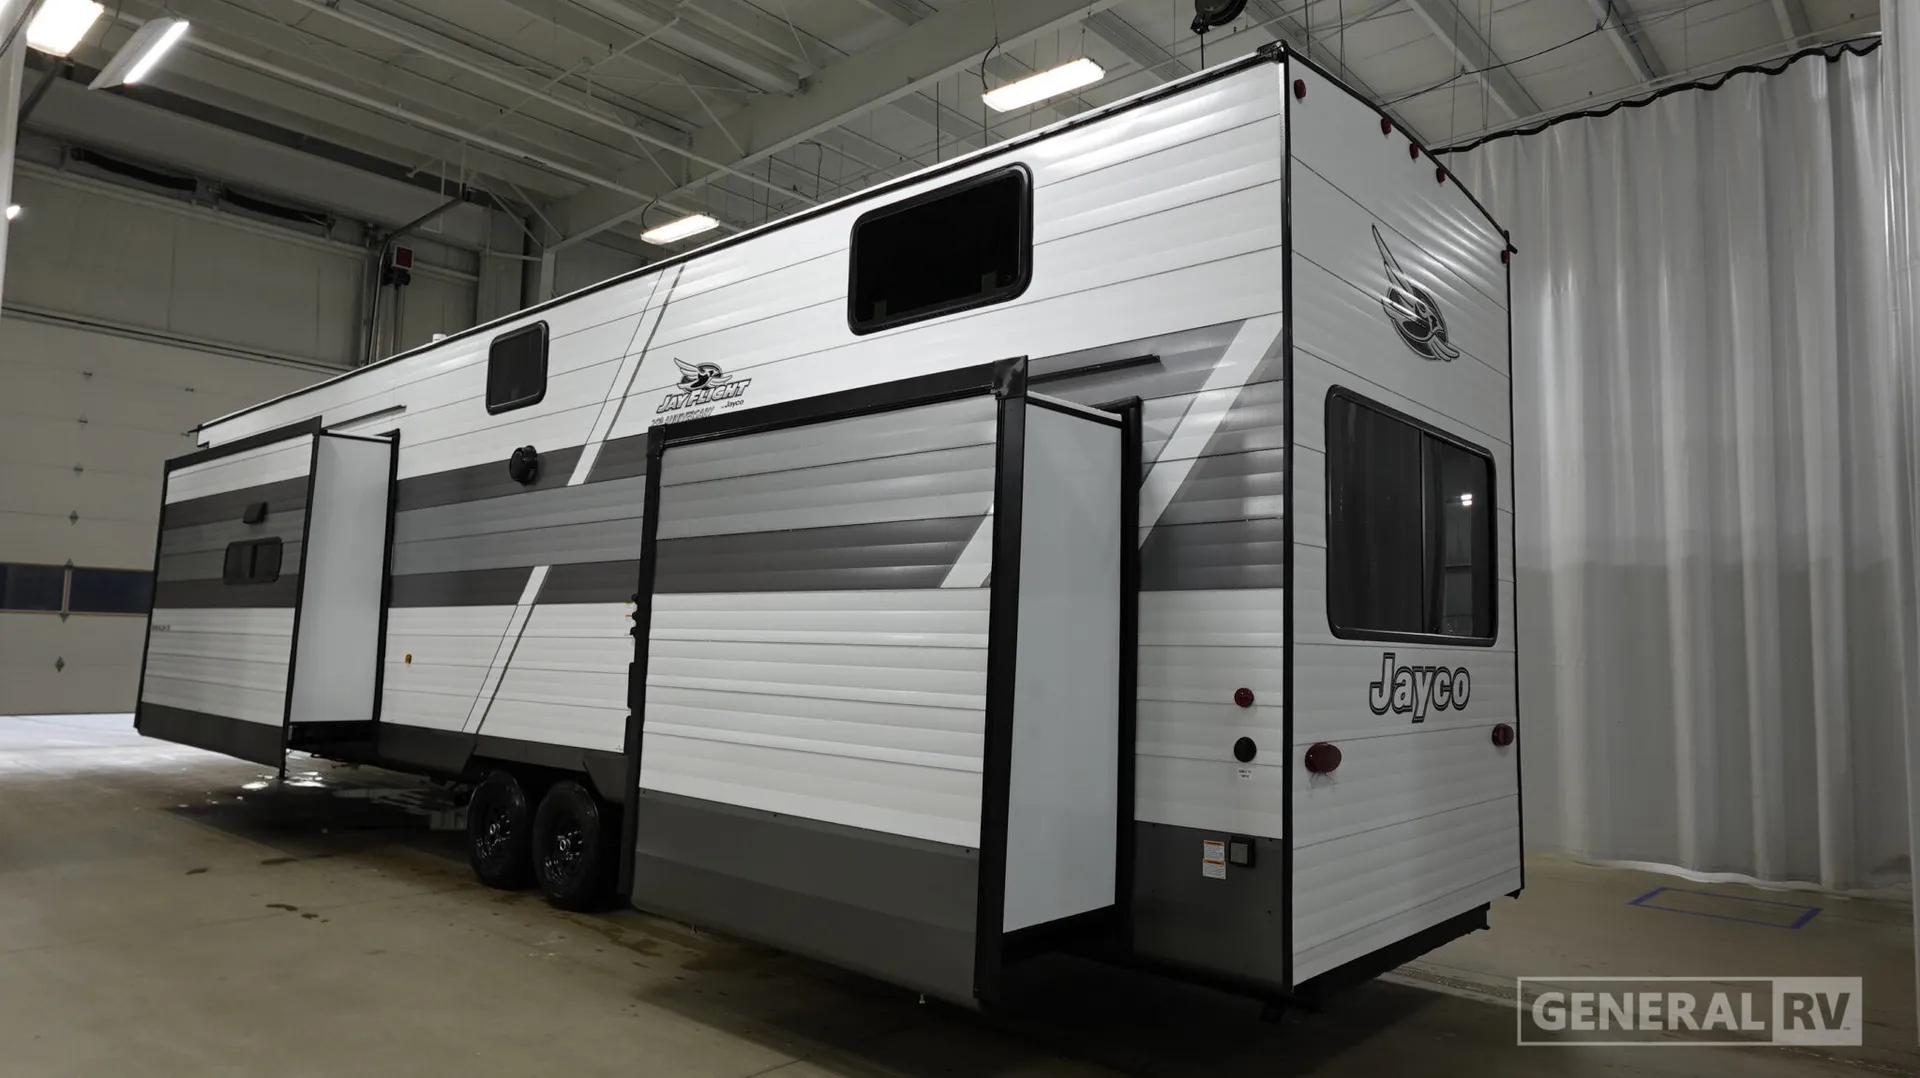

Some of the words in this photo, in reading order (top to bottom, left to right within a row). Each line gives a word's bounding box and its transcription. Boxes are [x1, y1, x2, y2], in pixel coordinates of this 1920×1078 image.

[656, 393, 689, 414] JAY
[686, 378, 752, 407] FLIGHT
[1369, 652, 1471, 724] Jayco
